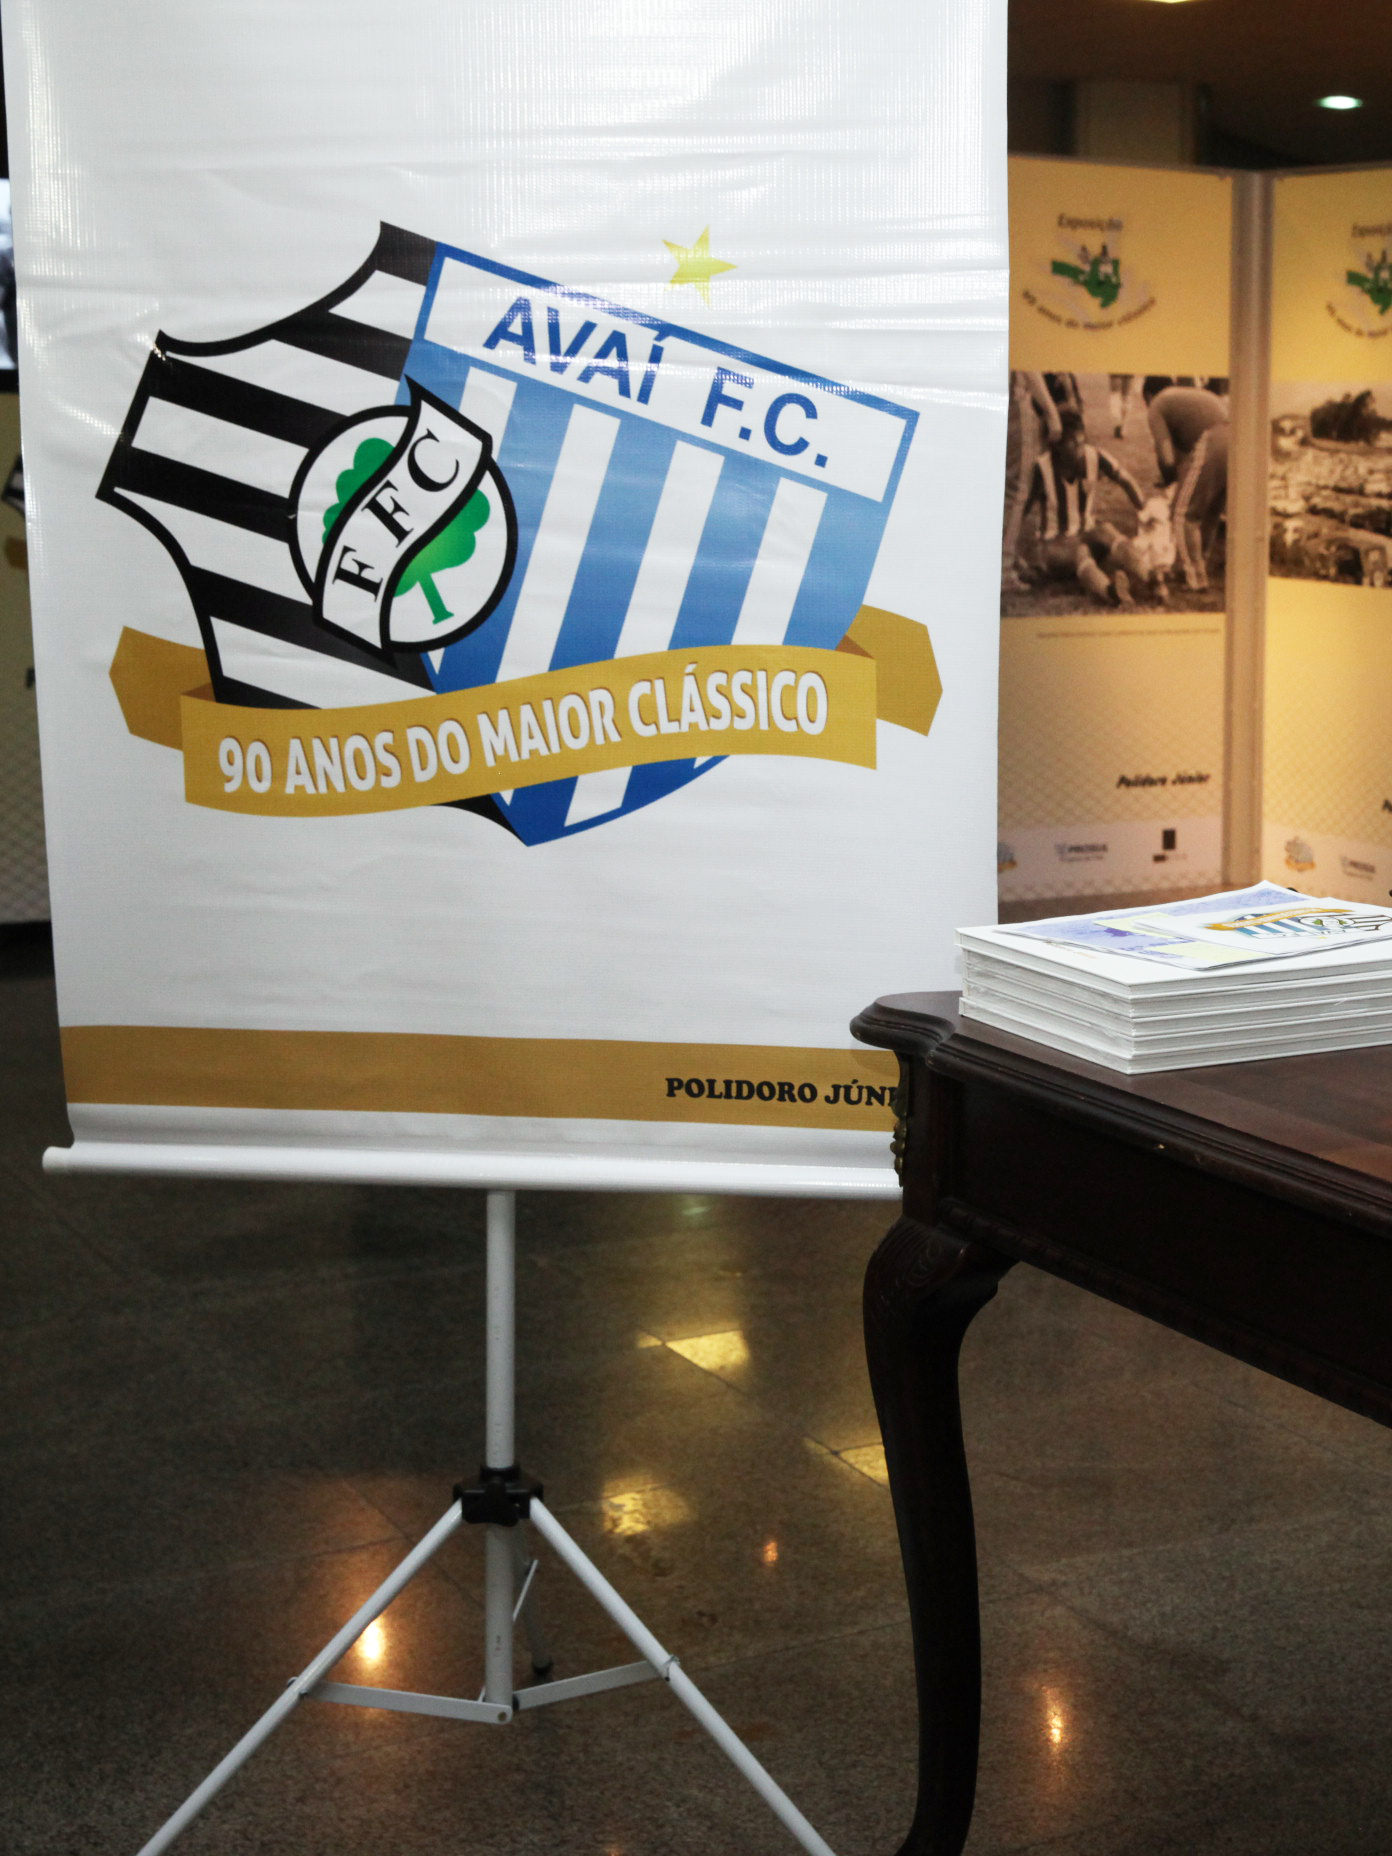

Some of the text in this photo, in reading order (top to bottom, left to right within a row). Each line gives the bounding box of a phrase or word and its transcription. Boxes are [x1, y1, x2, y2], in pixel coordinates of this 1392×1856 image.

[482, 296, 828, 469] AVAÍ F.C.
[218, 662, 828, 794] 90 ANOS DO MAIOR CLÁSSICO
[665, 1077, 818, 1103] POLIDORO
